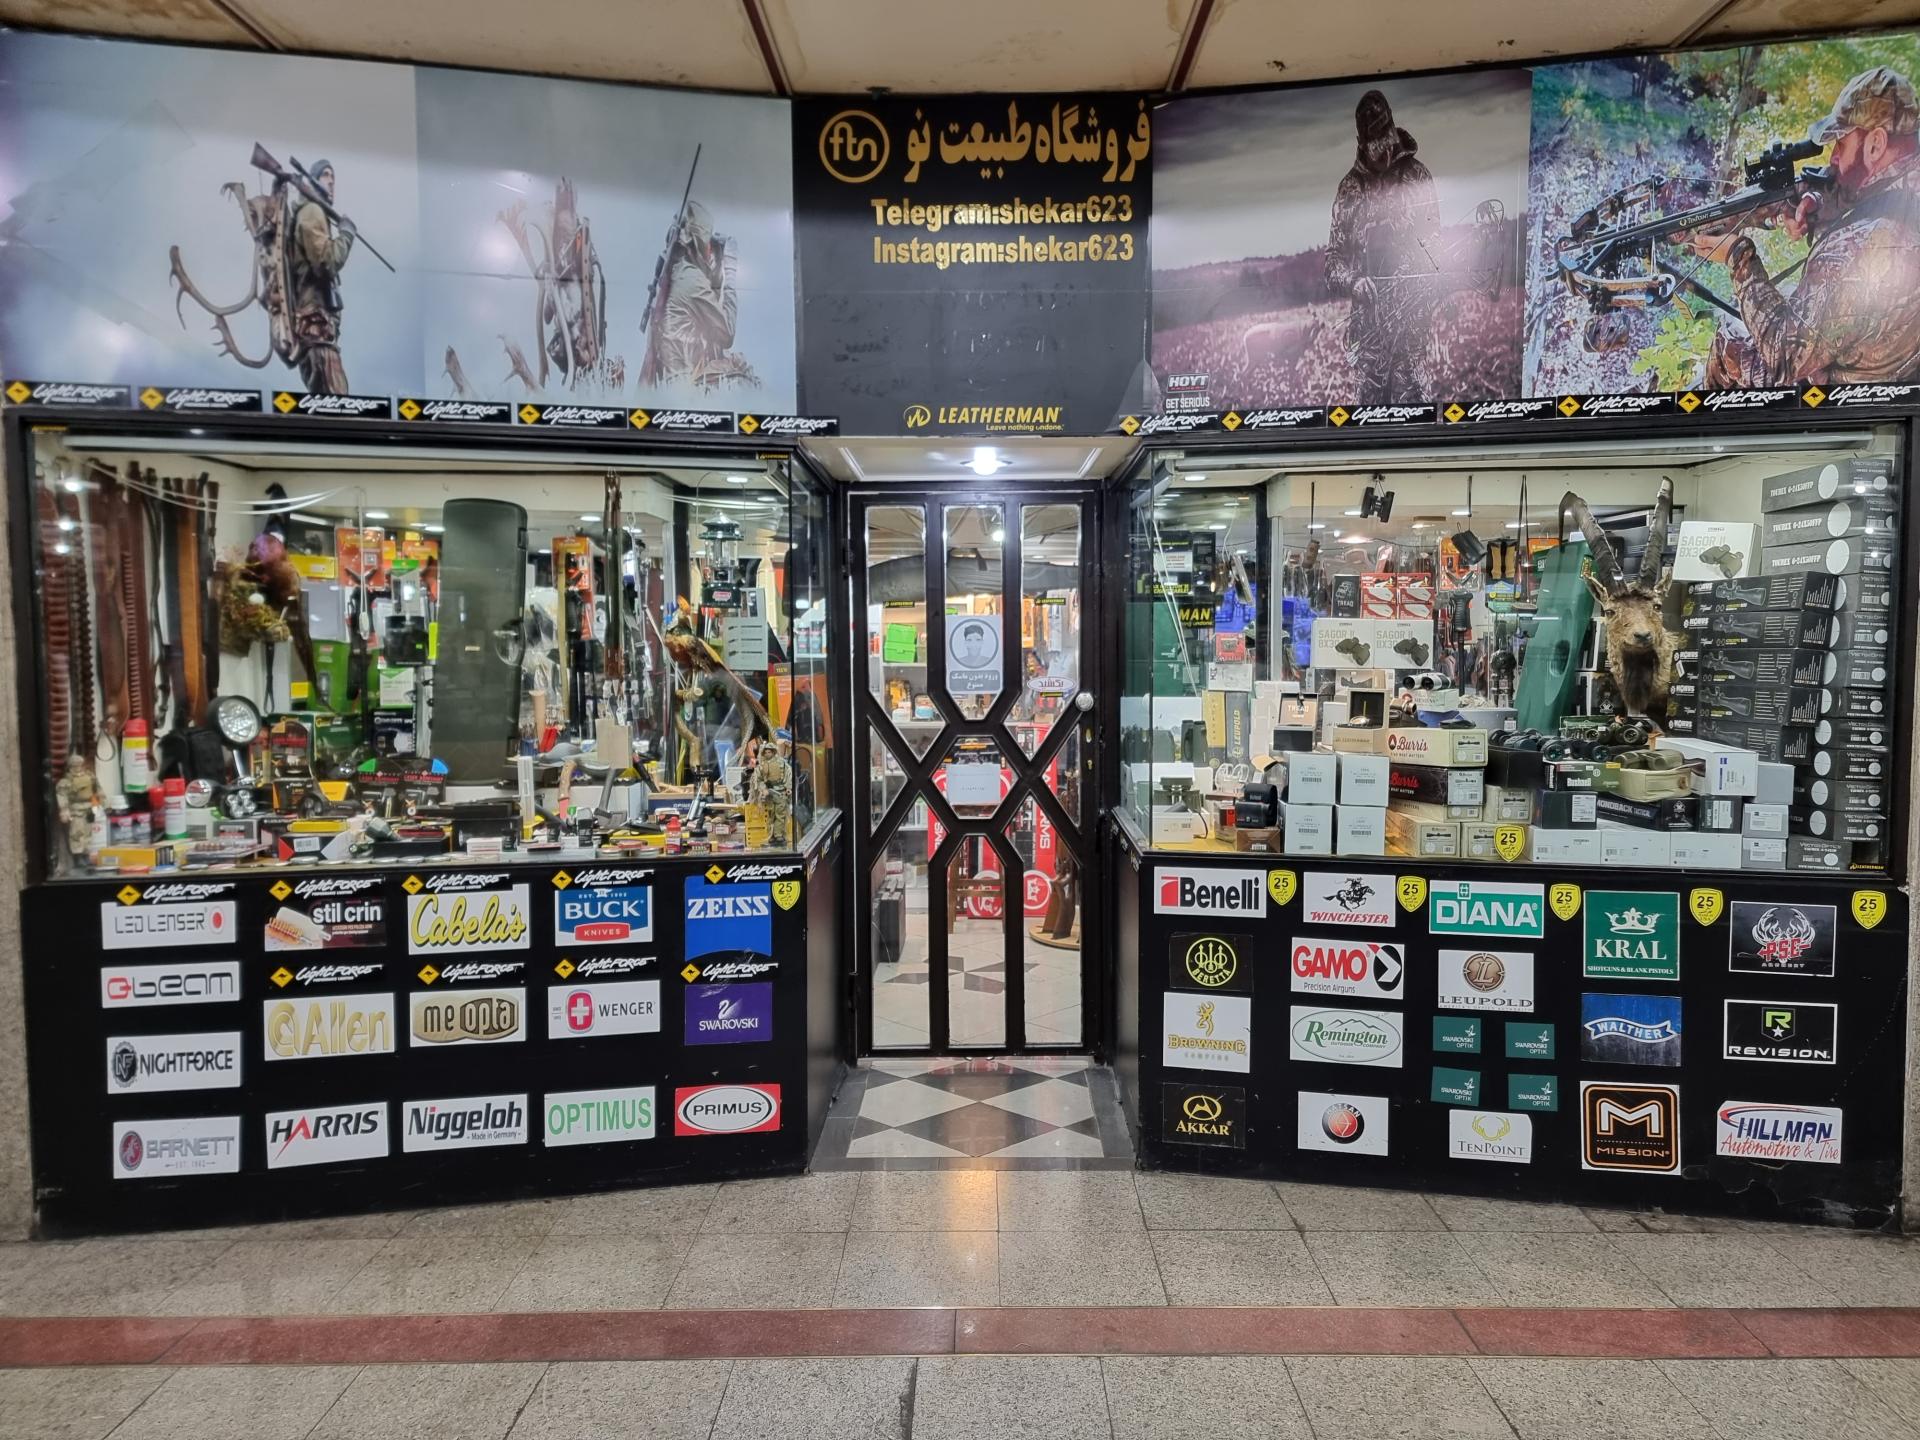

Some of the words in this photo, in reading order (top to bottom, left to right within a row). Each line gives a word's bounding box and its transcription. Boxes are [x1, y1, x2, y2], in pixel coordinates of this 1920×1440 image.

[904, 107, 931, 183] نو
[939, 101, 1033, 180] طبیعت
[1035, 98, 1151, 183] فروشگاه
[1168, 375, 1209, 388] HOYT
[1165, 398, 1180, 409] GET
[1180, 396, 1210, 408] SERIOUS
[938, 407, 1060, 424] LEATHERMAN
[1681, 536, 1716, 546] SAGOR
[1318, 630, 1347, 639] SAGOR
[1376, 630, 1404, 639] SAGOR
[1397, 736, 1428, 751] Burris
[1391, 771, 1419, 788] Burris
[1500, 832, 1517, 846] 25
[777, 882, 793, 895] 25
[1273, 876, 1289, 889] 25
[1403, 883, 1419, 896] 25
[1180, 876, 1260, 911] Benelli
[1556, 891, 1573, 904] 25
[1697, 895, 1714, 909] 25
[313, 903, 341, 924] stil
[344, 901, 382, 922] crin
[565, 901, 641, 920] BUCK
[687, 895, 769, 919] ZEISS
[1859, 898, 1877, 912] 25
[411, 893, 527, 947] Cabela's
[1310, 911, 1389, 925] WINCHESTER
[1436, 900, 1538, 928] DIANA
[583, 927, 622, 937] KNIVES
[1594, 938, 1668, 960] KRAL
[1293, 945, 1367, 982] GAMO
[1192, 968, 1231, 985] BERETTA
[1303, 981, 1331, 992] Precision
[1332, 983, 1356, 994] Airguns
[598, 1001, 654, 1017] WENGER
[1439, 995, 1533, 1008] LEUPOLD
[699, 1017, 759, 1032] SWAROVSKI
[1598, 1021, 1663, 1040] WALTHER
[1302, 1020, 1388, 1048] Remington
[1167, 1034, 1246, 1055] BROWNING
[139, 1050, 233, 1076] NIGHTFORCE
[1440, 1087, 1473, 1096] SWAROVSKI
[547, 1098, 652, 1136] OPTIMUS
[692, 1101, 762, 1117] PRIMUS
[270, 1110, 380, 1149] HARRIS
[408, 1101, 522, 1141] Niggeloh
[1176, 1119, 1230, 1136] AKKAR
[471, 1132, 486, 1141] Made
[493, 1130, 517, 1140] Germany
[1737, 1117, 1833, 1144] HILLMAN
[146, 1136, 235, 1159] BARNETT
[1597, 1146, 1666, 1158] MISSION
[1721, 1132, 1801, 1158] Automotive
[1804, 1140, 1814, 1159] &
[1819, 1138, 1840, 1160] Tire
